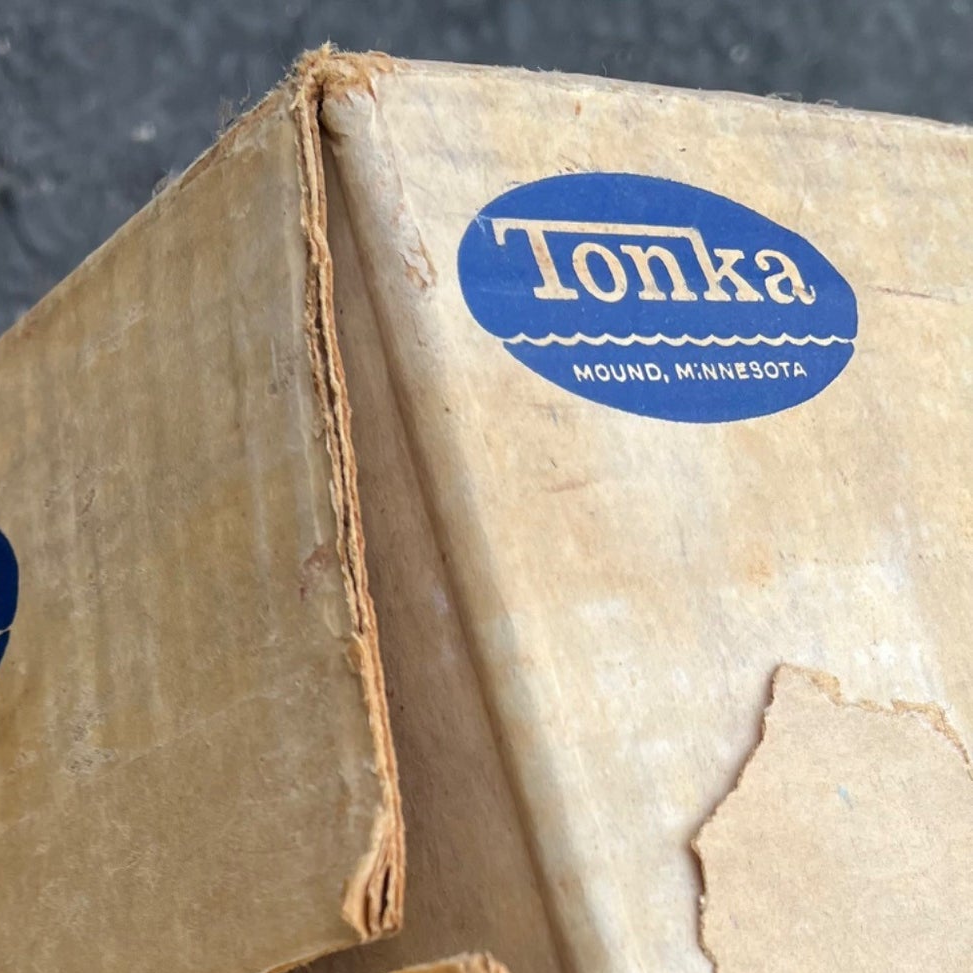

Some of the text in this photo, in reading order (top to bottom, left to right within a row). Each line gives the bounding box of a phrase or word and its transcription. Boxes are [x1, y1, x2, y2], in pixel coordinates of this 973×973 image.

[491, 217, 816, 305] Tonka
[572, 360, 807, 384] MOUND, MINNESOTA
